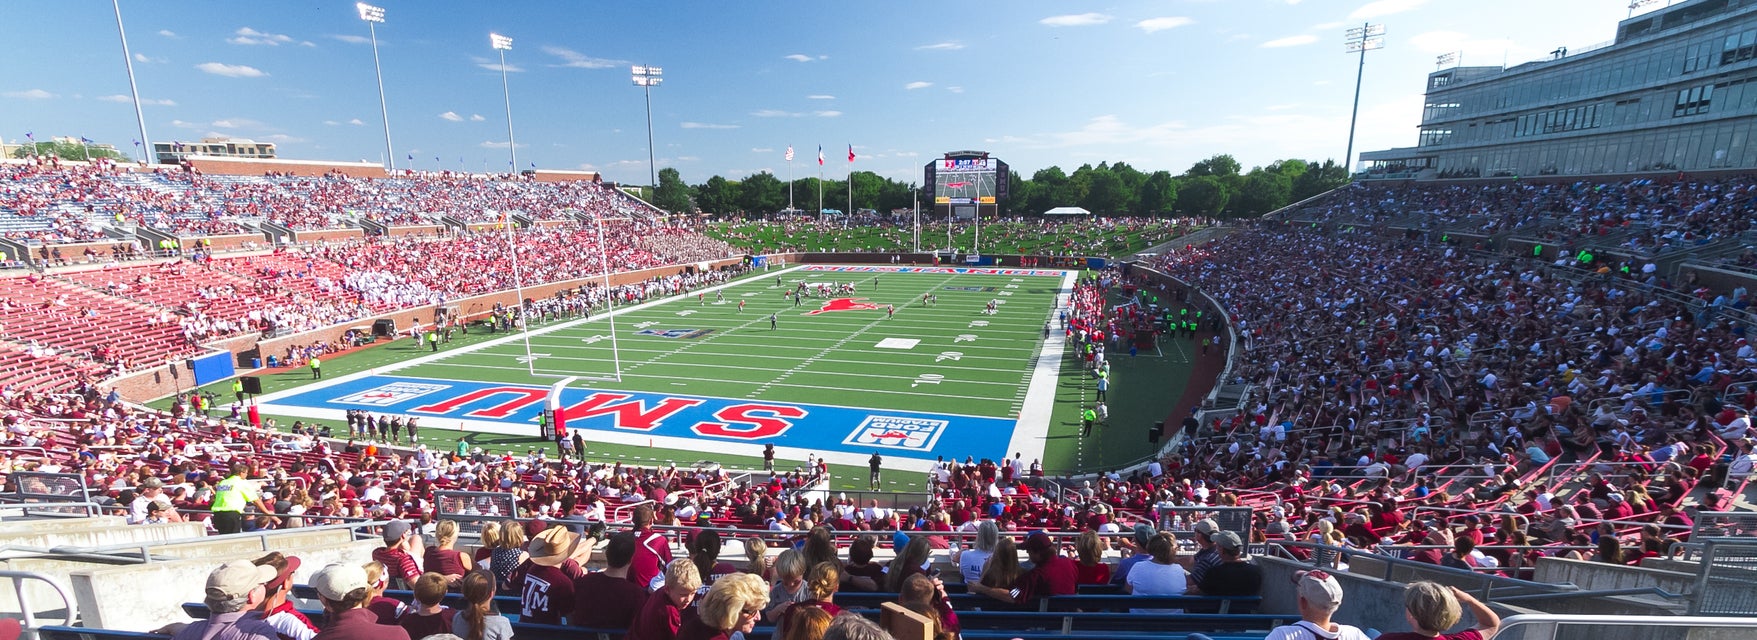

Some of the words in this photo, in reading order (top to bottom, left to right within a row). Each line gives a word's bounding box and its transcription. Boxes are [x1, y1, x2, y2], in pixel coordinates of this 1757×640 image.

[406, 385, 809, 440] SMU
[871, 422, 936, 432] FORD
[1251, 547, 1265, 555] 112
